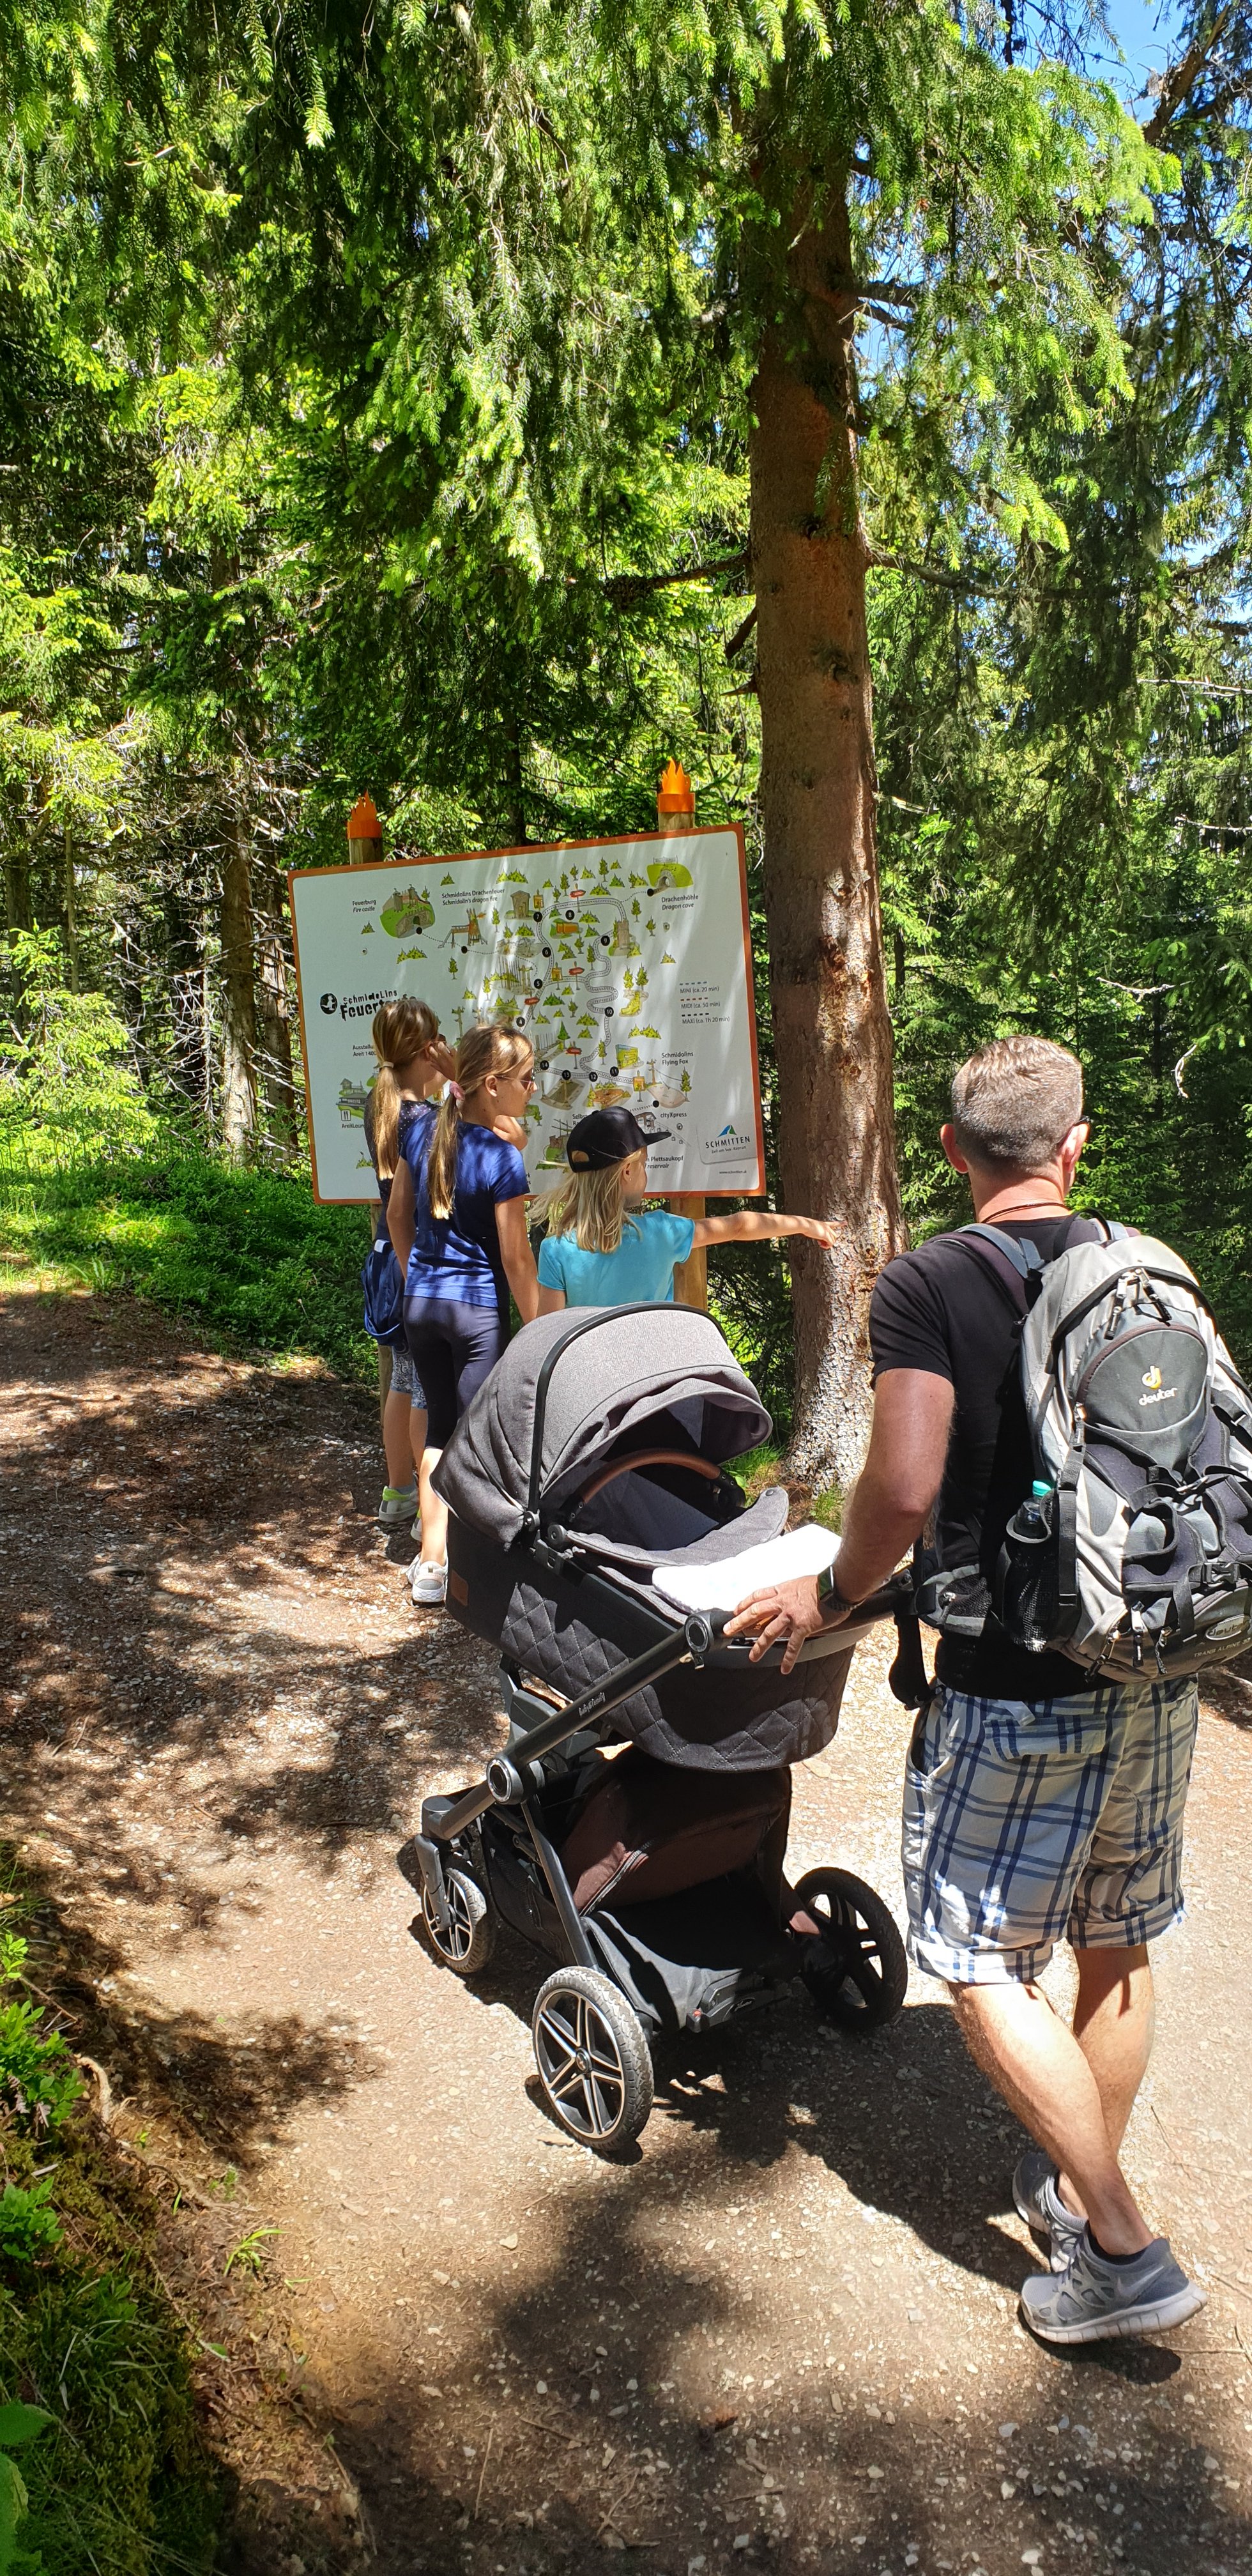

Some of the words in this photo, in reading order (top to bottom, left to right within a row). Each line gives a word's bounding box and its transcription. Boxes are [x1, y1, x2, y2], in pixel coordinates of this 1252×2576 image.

[661, 893, 699, 903] Drachenhöhle
[705, 1136, 750, 1149] SCHMITTEN
[1138, 1387, 1178, 1406] deuter
[1194, 1648, 1216, 1657] TRANS
[1218, 1641, 1241, 1651] ALPINE
